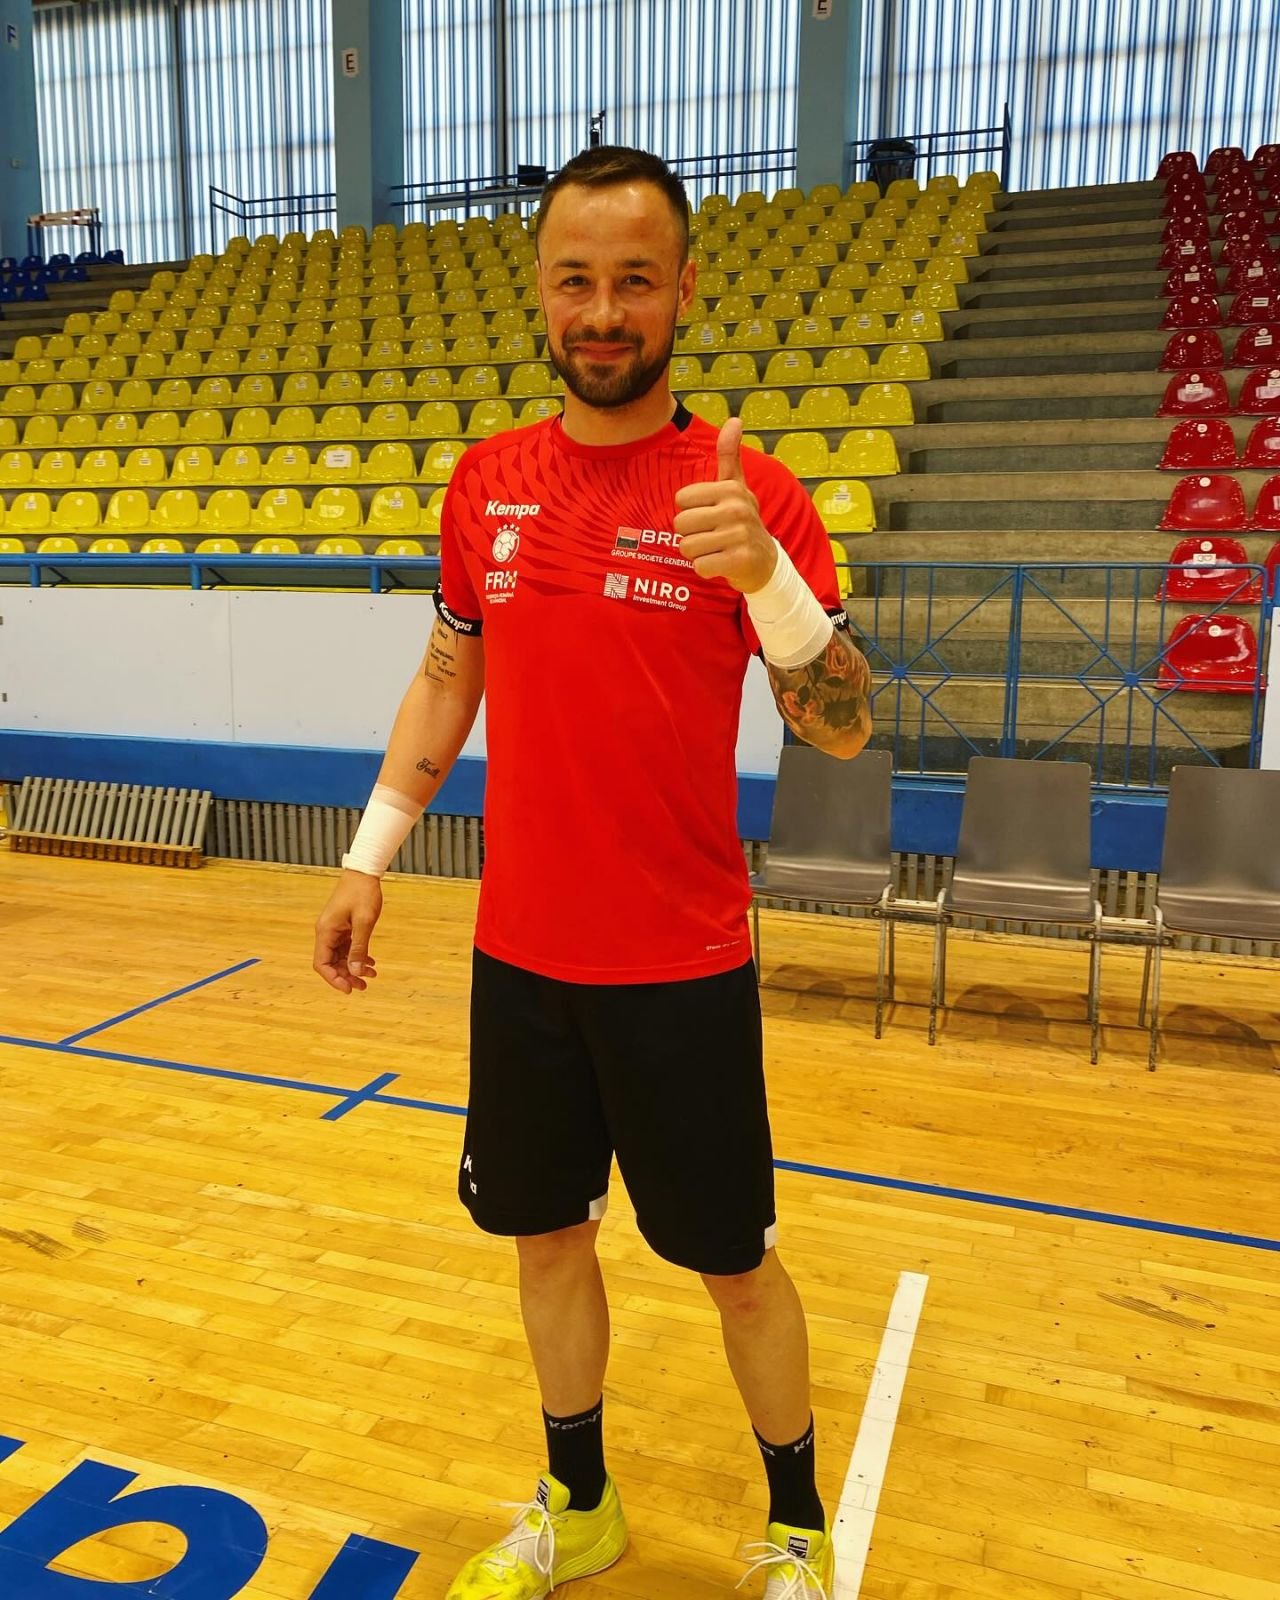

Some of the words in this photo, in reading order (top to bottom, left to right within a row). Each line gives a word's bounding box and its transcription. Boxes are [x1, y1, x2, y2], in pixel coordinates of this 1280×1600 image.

[7, 24, 17, 44] F
[345, 53, 355, 70] E
[484, 500, 541, 520] Kempa
[611, 549, 637, 559] GROUPE
[634, 577, 690, 602] NIRO
[633, 594, 667, 607] Investment
[668, 601, 687, 612] Group
[439, 601, 473, 632] Kempa
